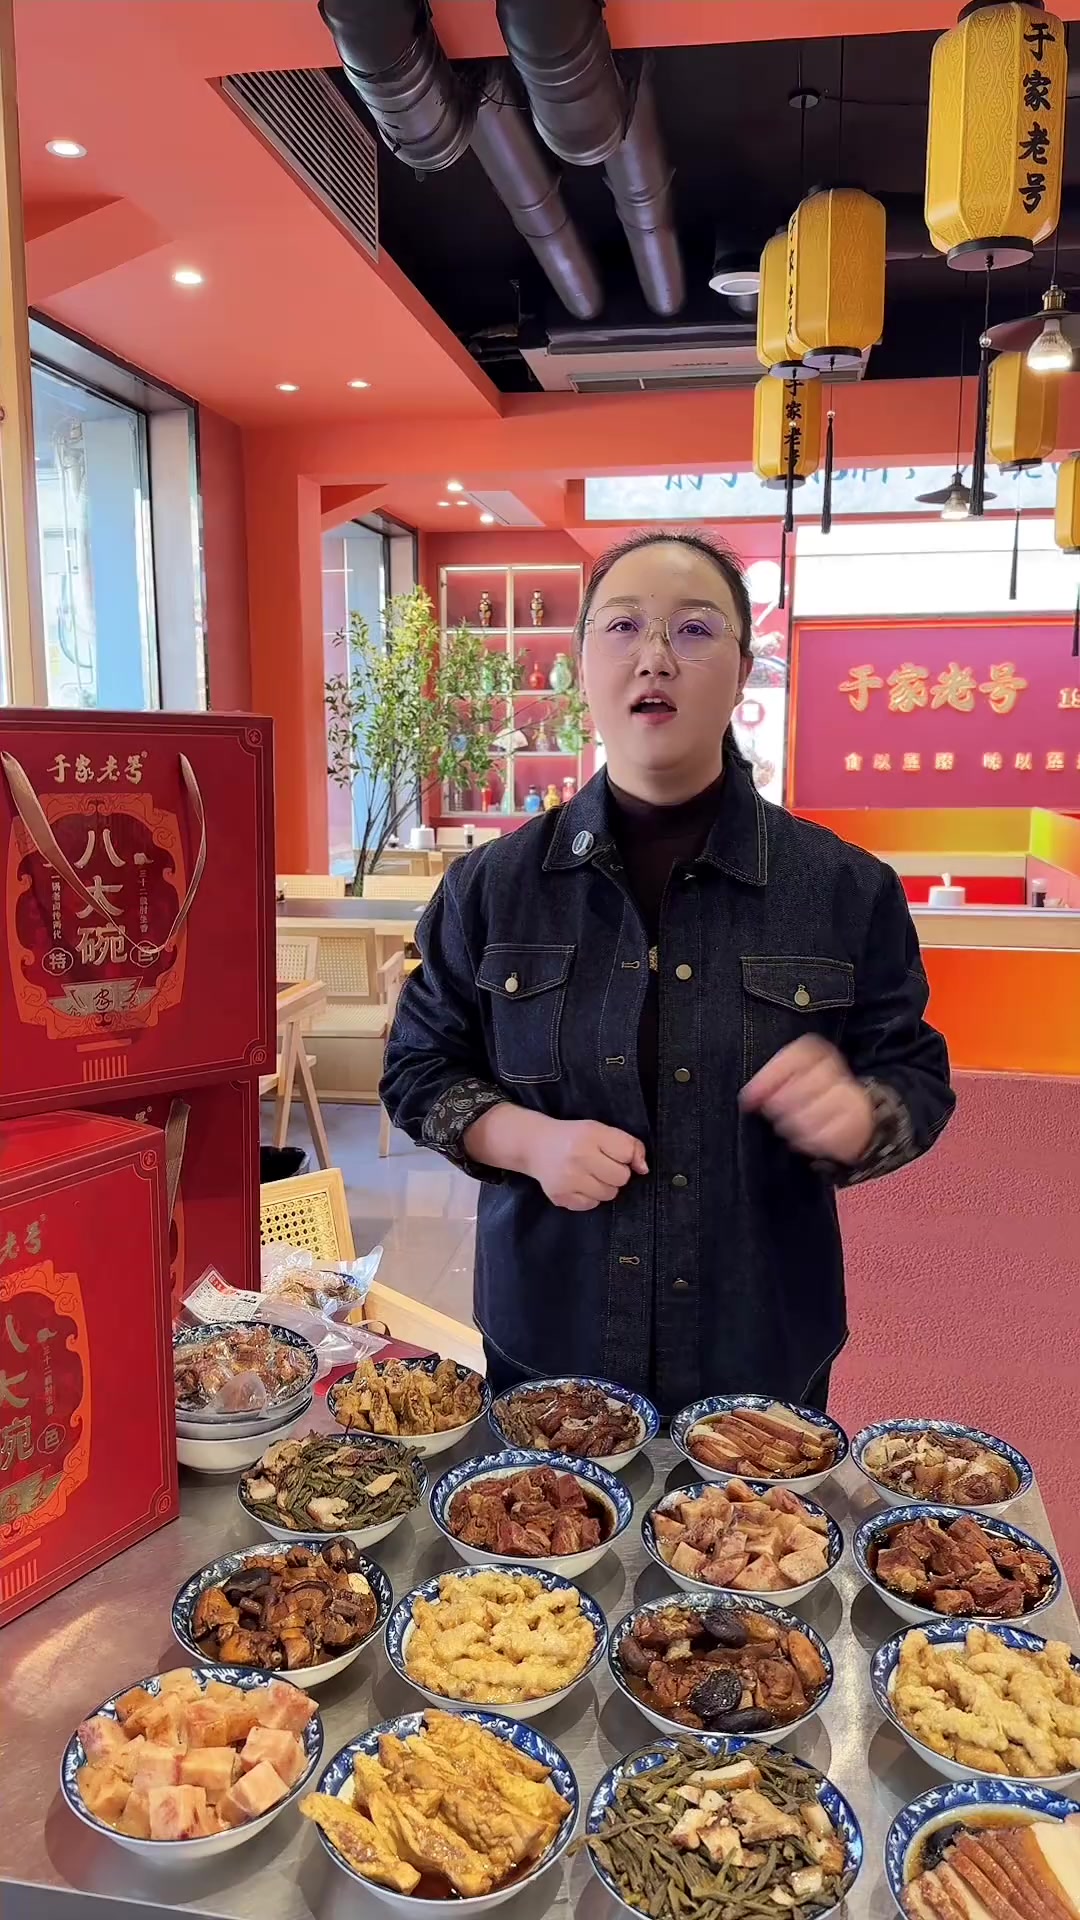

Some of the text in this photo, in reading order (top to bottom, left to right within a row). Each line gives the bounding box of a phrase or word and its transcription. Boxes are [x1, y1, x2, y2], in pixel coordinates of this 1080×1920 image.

[1018, 23, 1056, 214] 于家老号
[838, 662, 1027, 714] 于家老号
[46, 753, 143, 785] 于家老号
[983, 751, 1080, 772] 味以至
[74, 828, 128, 966] 八大碗
[49, 952, 67, 970] 特
